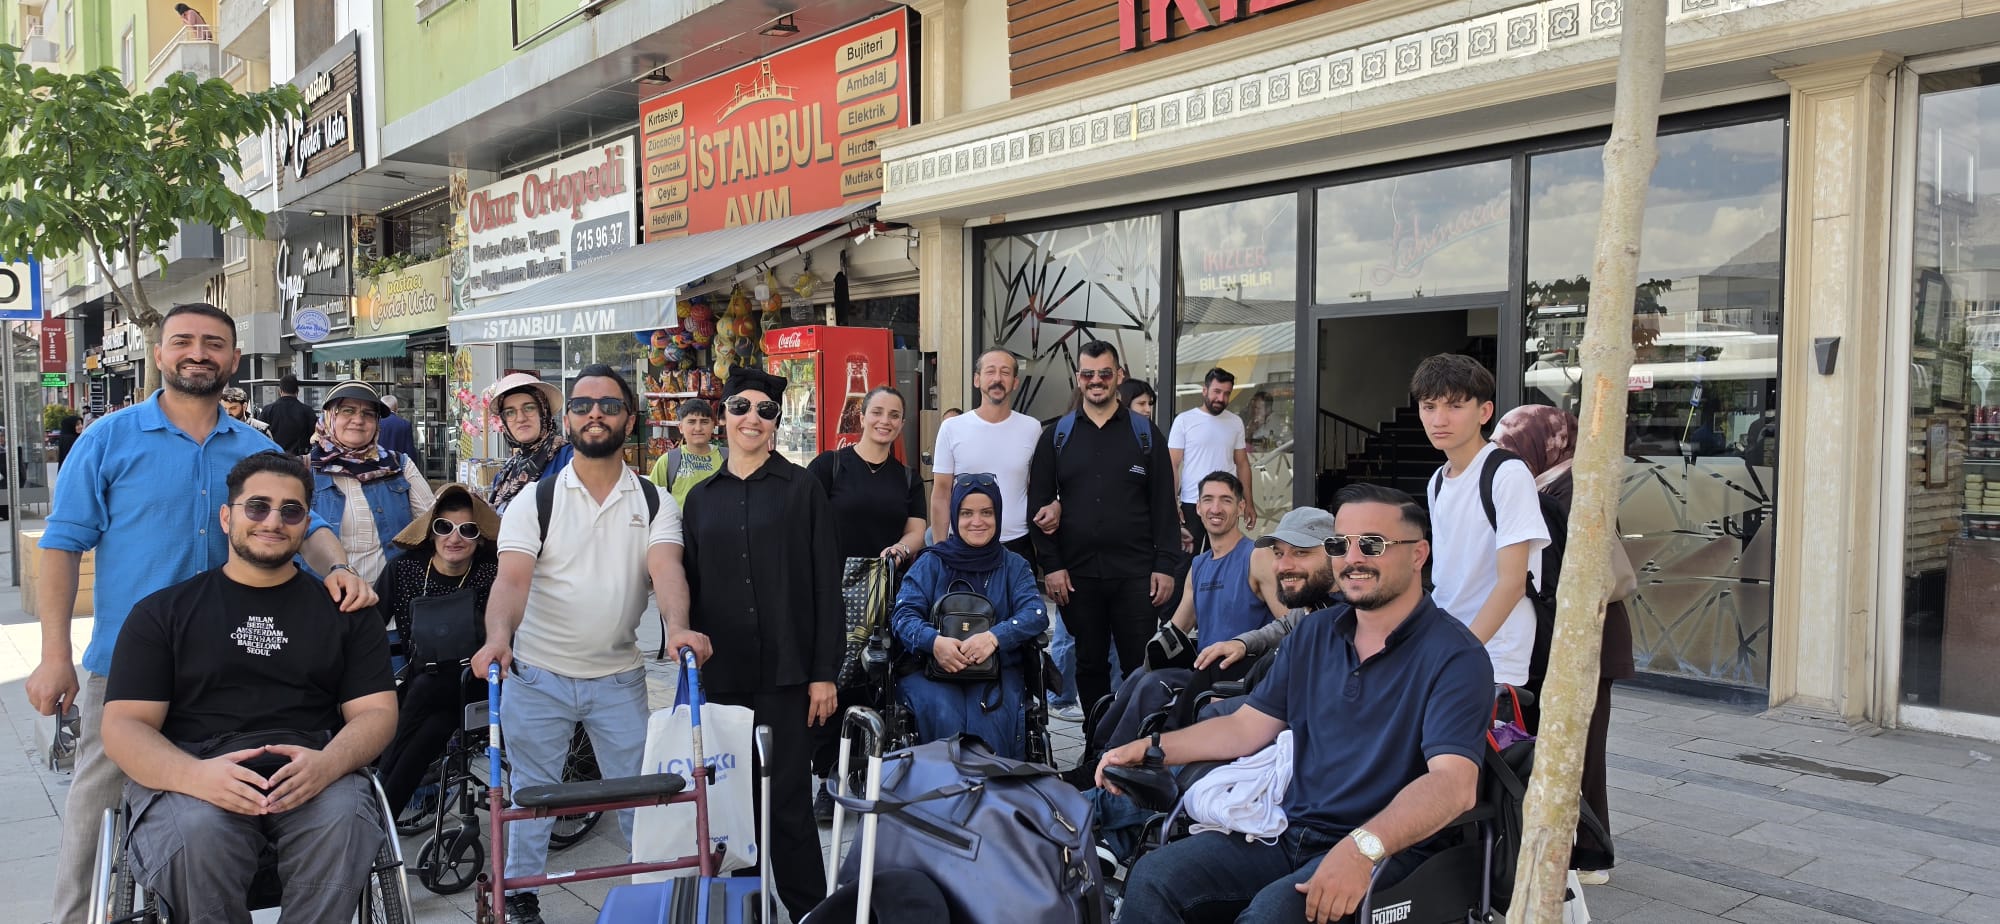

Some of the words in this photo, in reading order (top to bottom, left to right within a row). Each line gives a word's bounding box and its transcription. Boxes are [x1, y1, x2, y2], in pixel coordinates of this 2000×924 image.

[847, 37, 883, 64] Bujiteri
[846, 68, 887, 93] Ambalaj
[648, 107, 678, 127] Kırtasiye
[848, 104, 886, 125] Elektrik
[325, 110, 346, 147] Usta
[648, 132, 681, 152] Züccaciye
[690, 102, 834, 192] İSTANBUL
[652, 161, 681, 176] Oyuncak
[845, 170, 874, 187] Mutfak
[469, 190, 519, 233] Okur
[522, 145, 627, 220] Ortopedi
[657, 185, 677, 201] Çeyiz
[652, 208, 683, 226] Hediyelik
[725, 186, 792, 229] AVM
[576, 229, 594, 252] 215
[595, 225, 608, 247] 96
[610, 221, 623, 244] 37
[370, 294, 406, 331] Cevdet
[407, 289, 436, 316] Usta
[572, 308, 616, 333] AVM
[778, 332, 802, 348] Coca-Cola
[1628, 375, 1651, 385] PALI
[230, 633, 288, 643] COPENHAGEN
[236, 627, 283, 636] AMSTERDAM
[238, 640, 281, 649] BARCELONA
[247, 647, 271, 656] SEOUL
